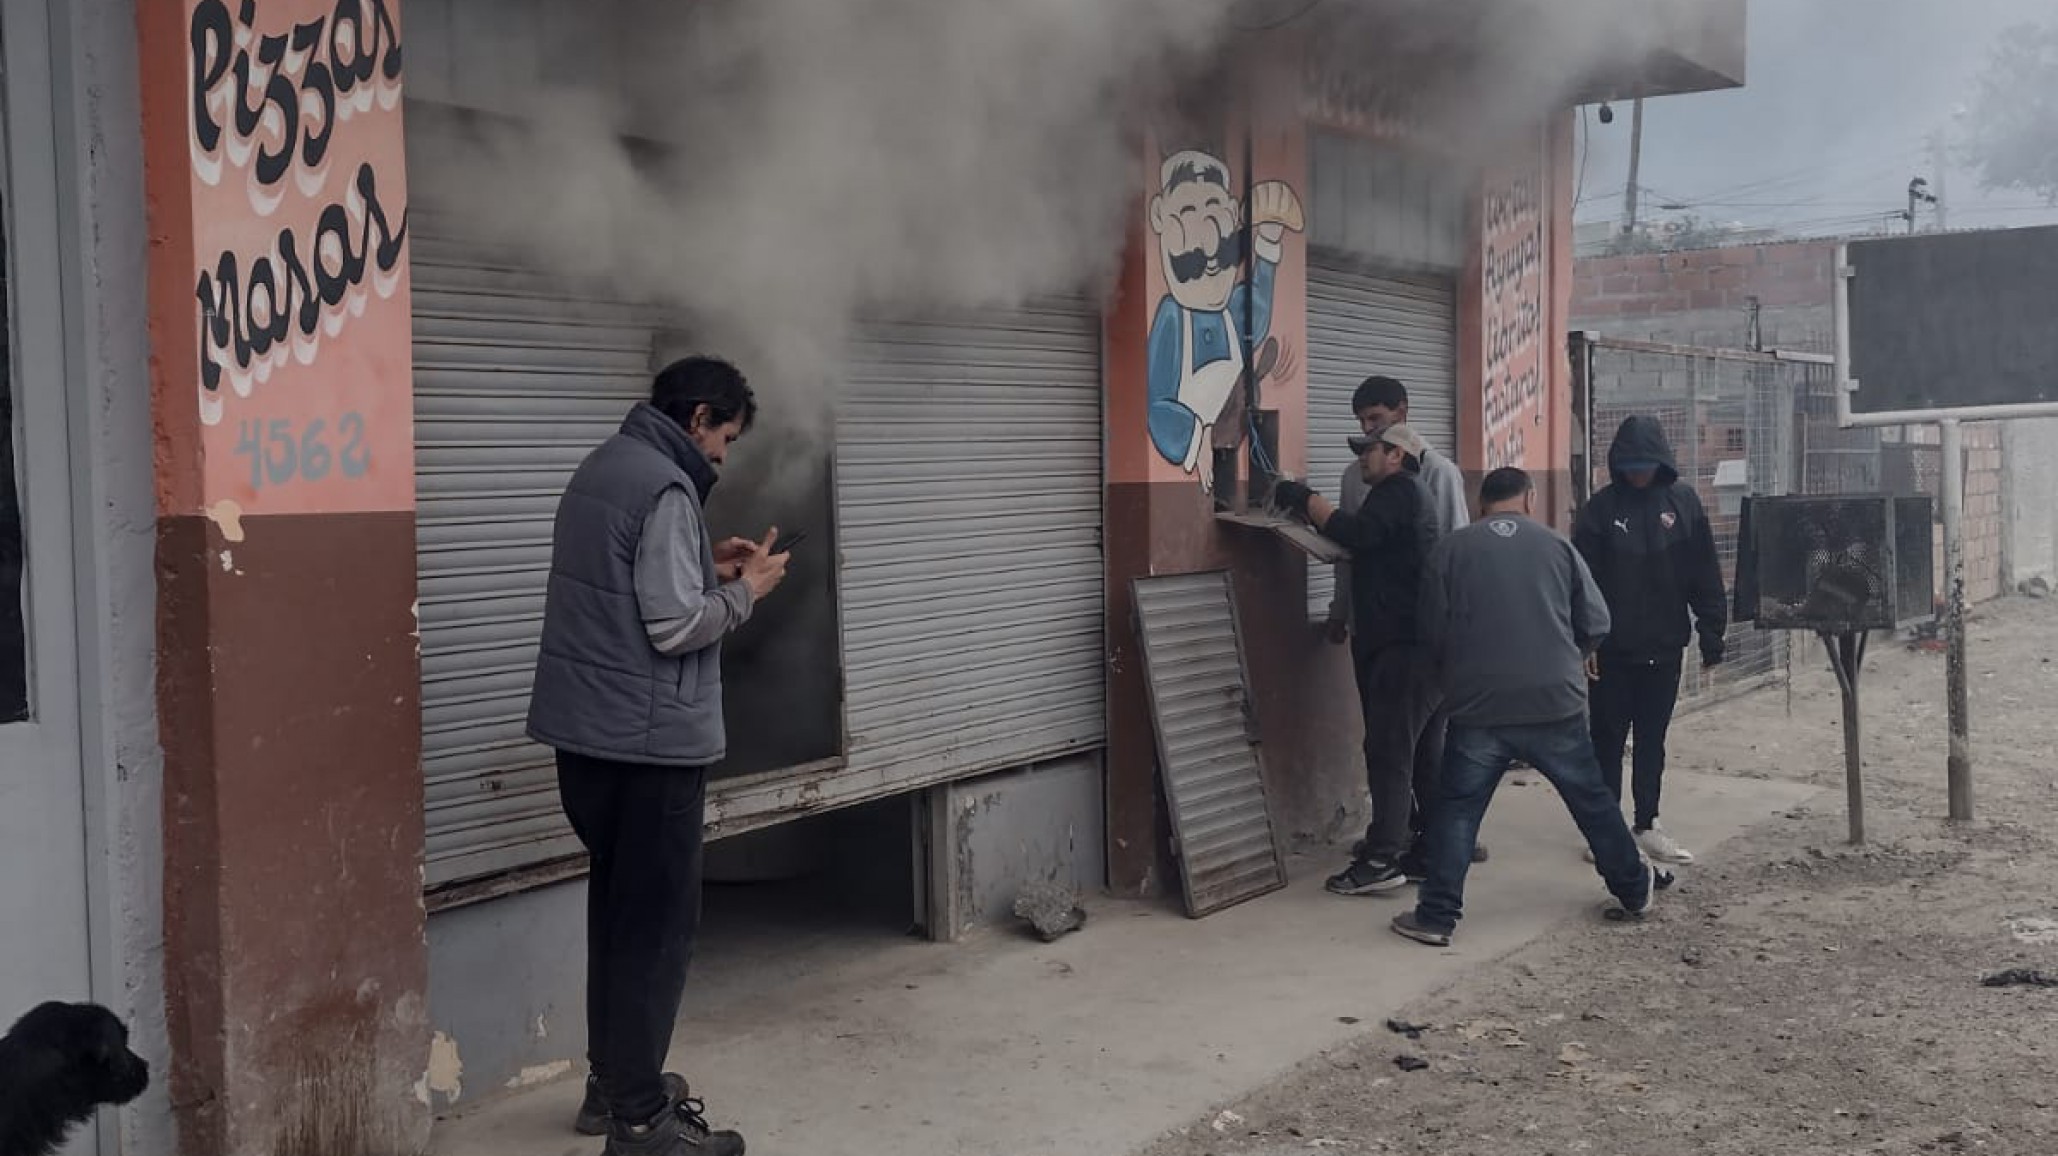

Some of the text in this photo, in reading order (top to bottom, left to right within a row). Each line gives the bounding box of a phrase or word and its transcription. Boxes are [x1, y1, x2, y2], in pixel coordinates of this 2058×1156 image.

[190, 0, 402, 185] Pizzas
[196, 162, 408, 391] Masas
[234, 411, 372, 489] 4562
